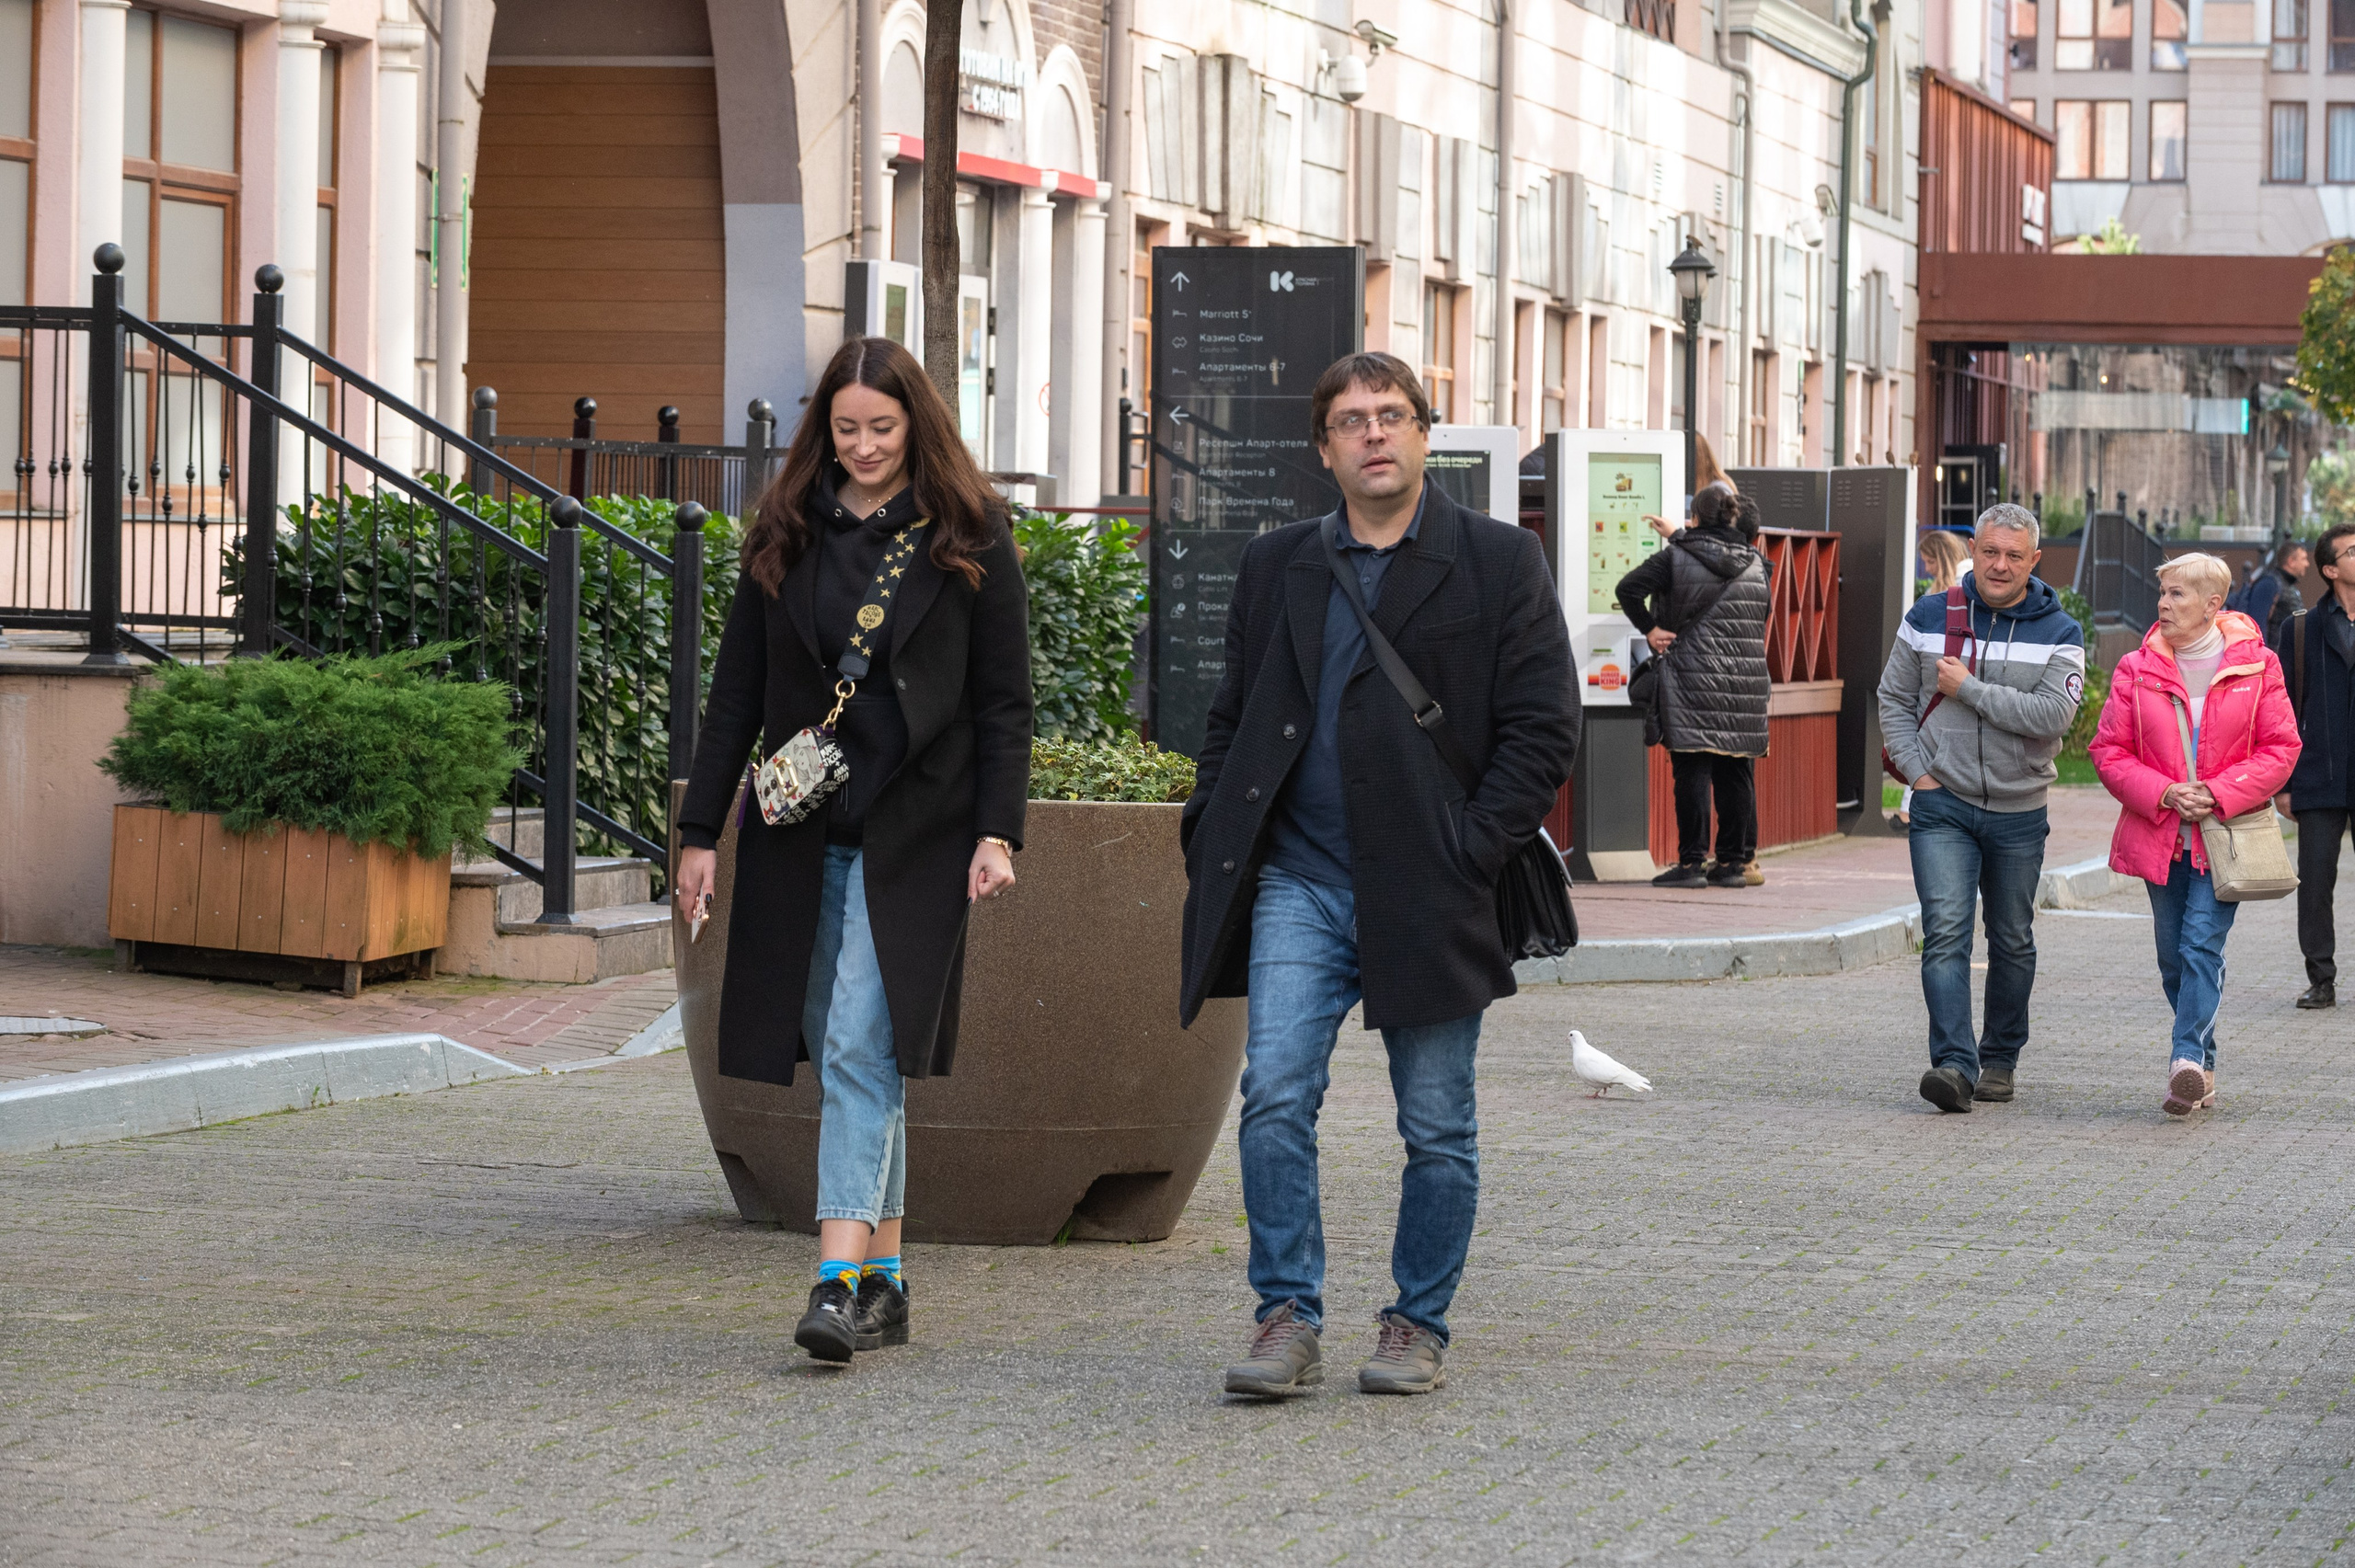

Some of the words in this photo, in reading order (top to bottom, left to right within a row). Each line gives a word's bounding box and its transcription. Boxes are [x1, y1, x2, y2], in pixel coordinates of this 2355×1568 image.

[1200, 309, 1239, 319] Marriott
[1200, 334, 1235, 343] Казино
[1238, 334, 1263, 343] Сочи
[1199, 362, 1267, 372] Апартаменты
[1269, 362, 1286, 372] 6-7
[1199, 439, 1243, 449] Ресепшн
[1246, 439, 1308, 450] Апарт-отеля
[1199, 467, 1266, 477] Апартаменты
[1269, 467, 1276, 476] 8
[1199, 497, 1223, 507] Парк
[1225, 497, 1269, 507] Времена
[1271, 497, 1294, 506] Года
[1198, 601, 1230, 612] Прока
[820, 742, 837, 758] MARC
